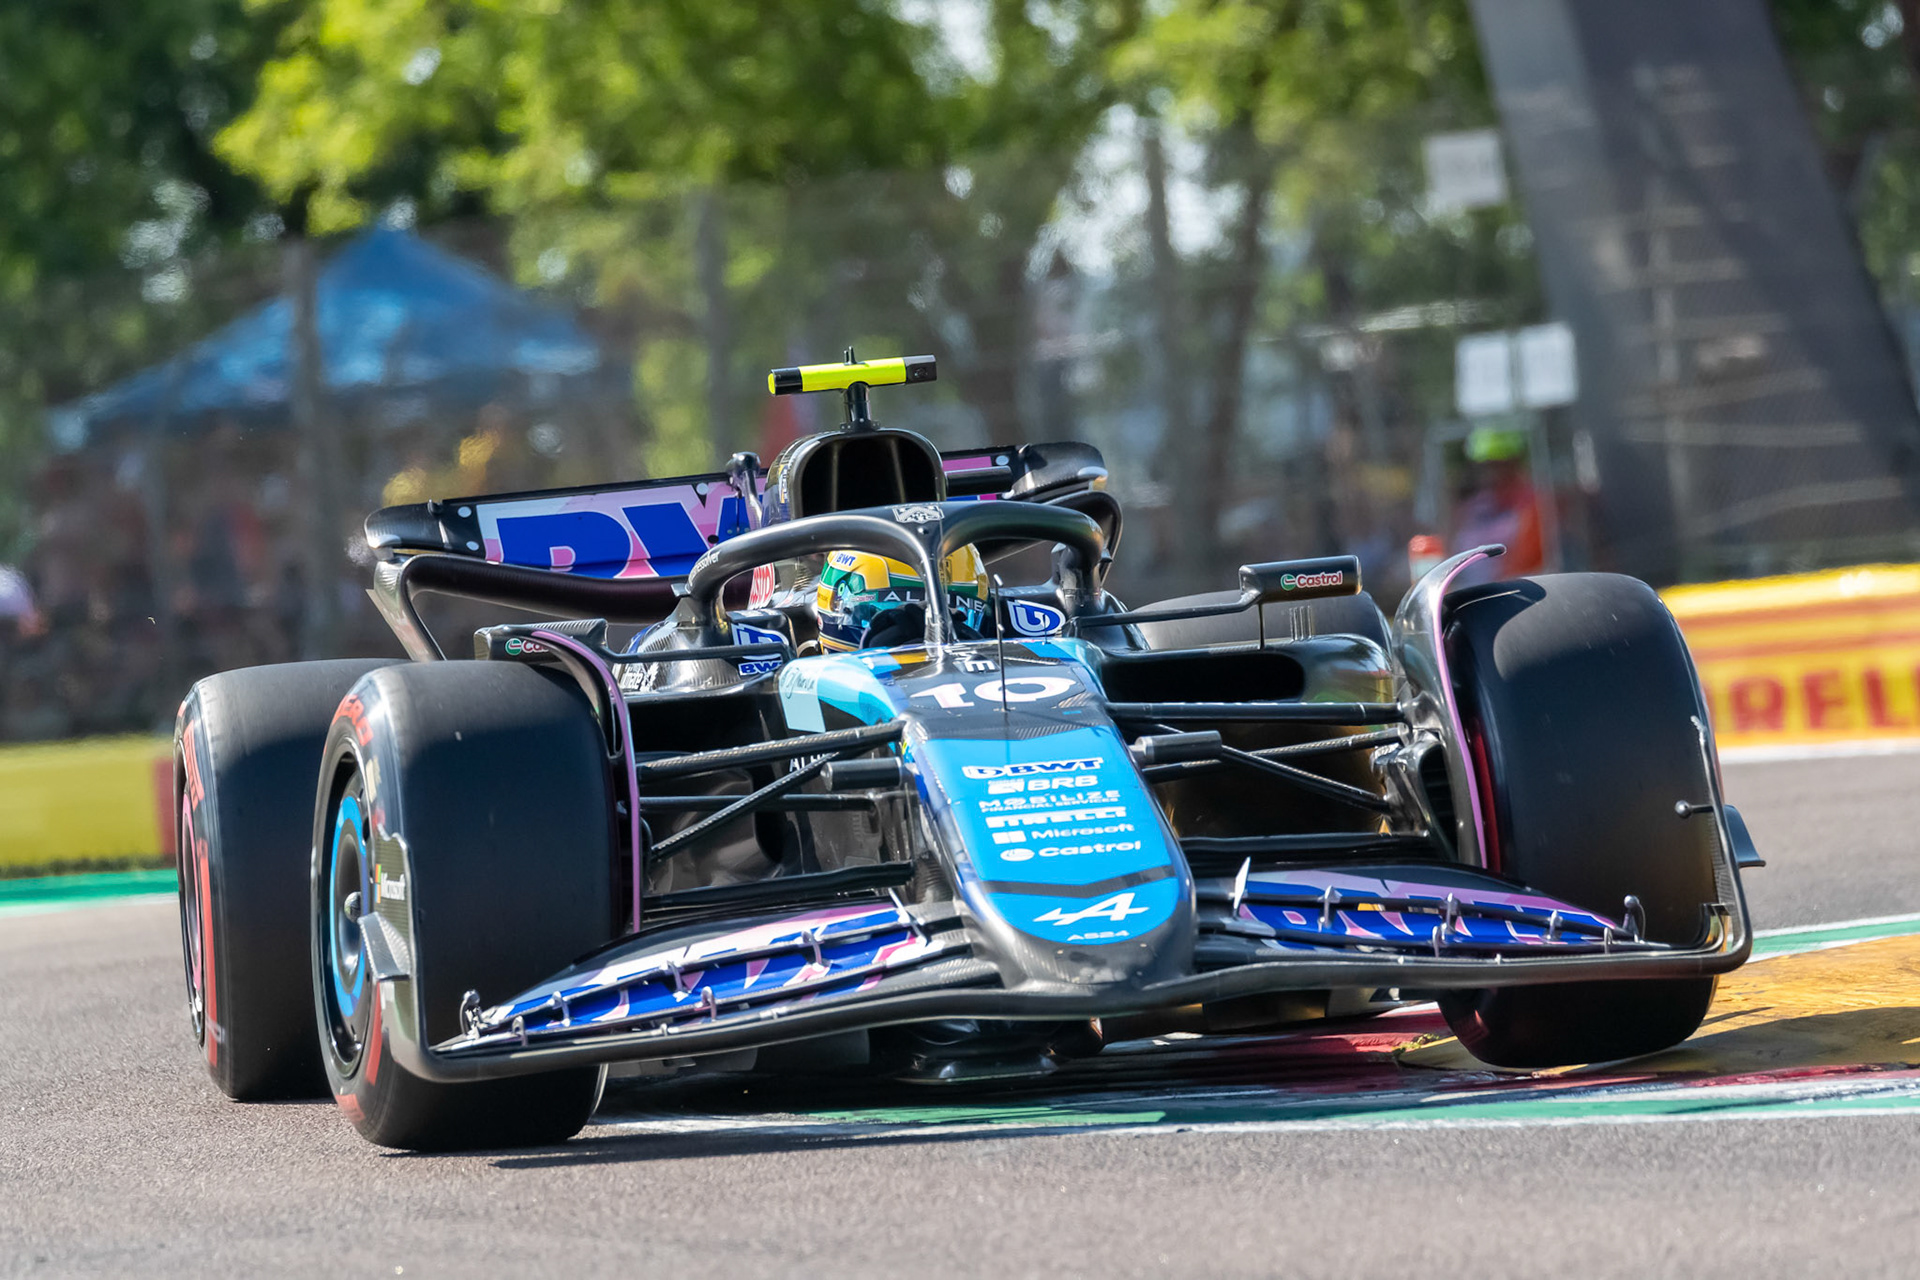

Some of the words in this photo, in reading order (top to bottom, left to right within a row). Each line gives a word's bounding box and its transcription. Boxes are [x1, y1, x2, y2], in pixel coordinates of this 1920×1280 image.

[838, 553, 856, 567] BWT
[1296, 570, 1343, 588] Castrol
[911, 676, 1076, 708] 10
[1007, 757, 1103, 776] BWT
[1028, 775, 1098, 791] BRB
[978, 790, 1121, 809] MOBILIZE
[981, 802, 1053, 813] FINANCIAL
[1055, 797, 1119, 808] SERVICES
[985, 806, 1127, 828] PIRELLI
[1031, 823, 1135, 840] Microsoft
[1038, 840, 1141, 857] Castrol
